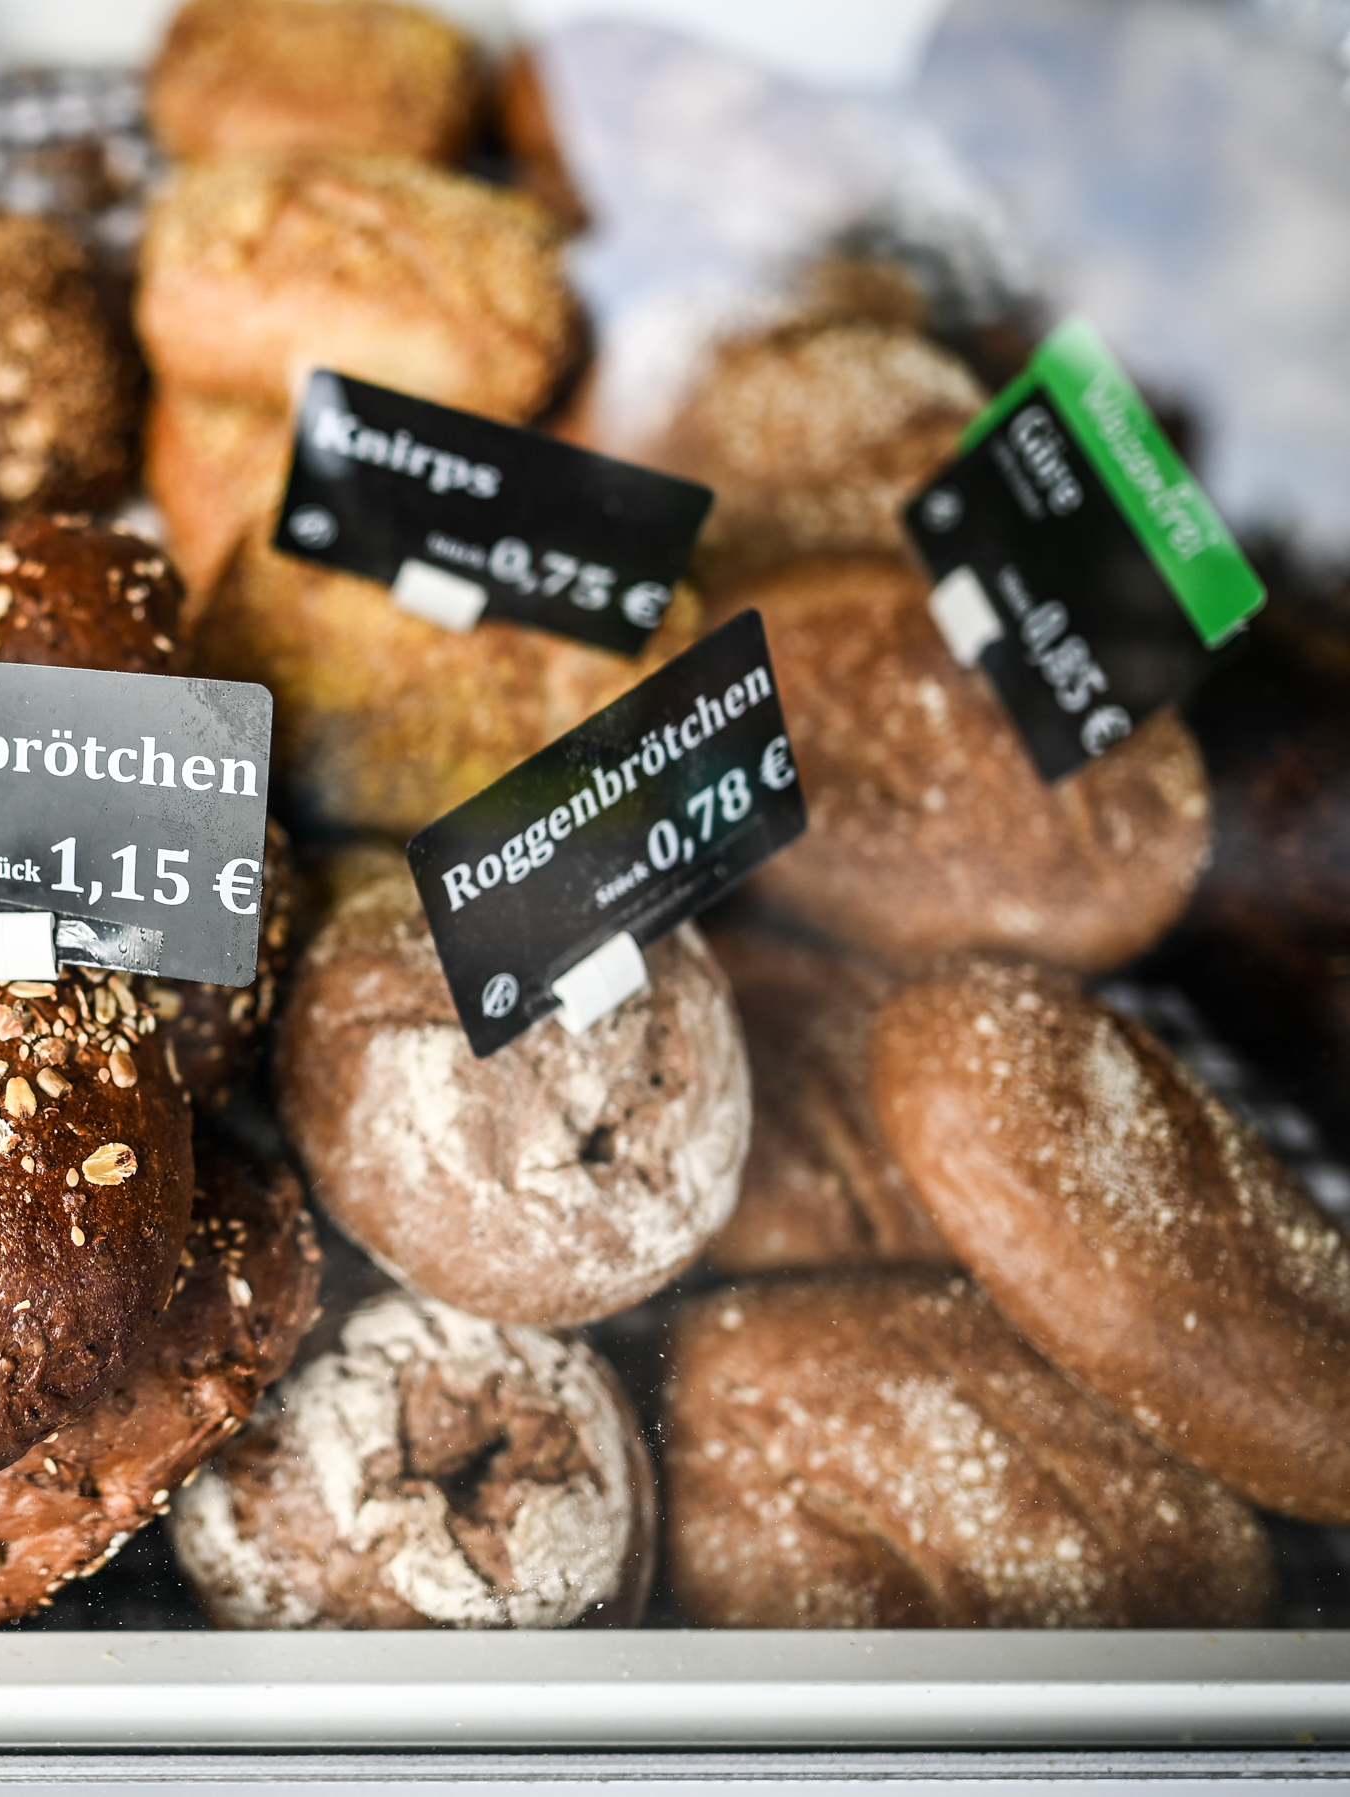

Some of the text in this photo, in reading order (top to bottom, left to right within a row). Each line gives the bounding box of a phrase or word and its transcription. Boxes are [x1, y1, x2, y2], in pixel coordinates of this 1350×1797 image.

[314, 407, 502, 499] Knirps
[488, 537, 616, 610] 0,75
[622, 582, 670, 628] €
[441, 665, 772, 912] Roggenbrötchen
[647, 767, 753, 872] 0,78
[759, 734, 796, 791] €
[50, 836, 190, 907] 1,15
[212, 857, 260, 915] €
